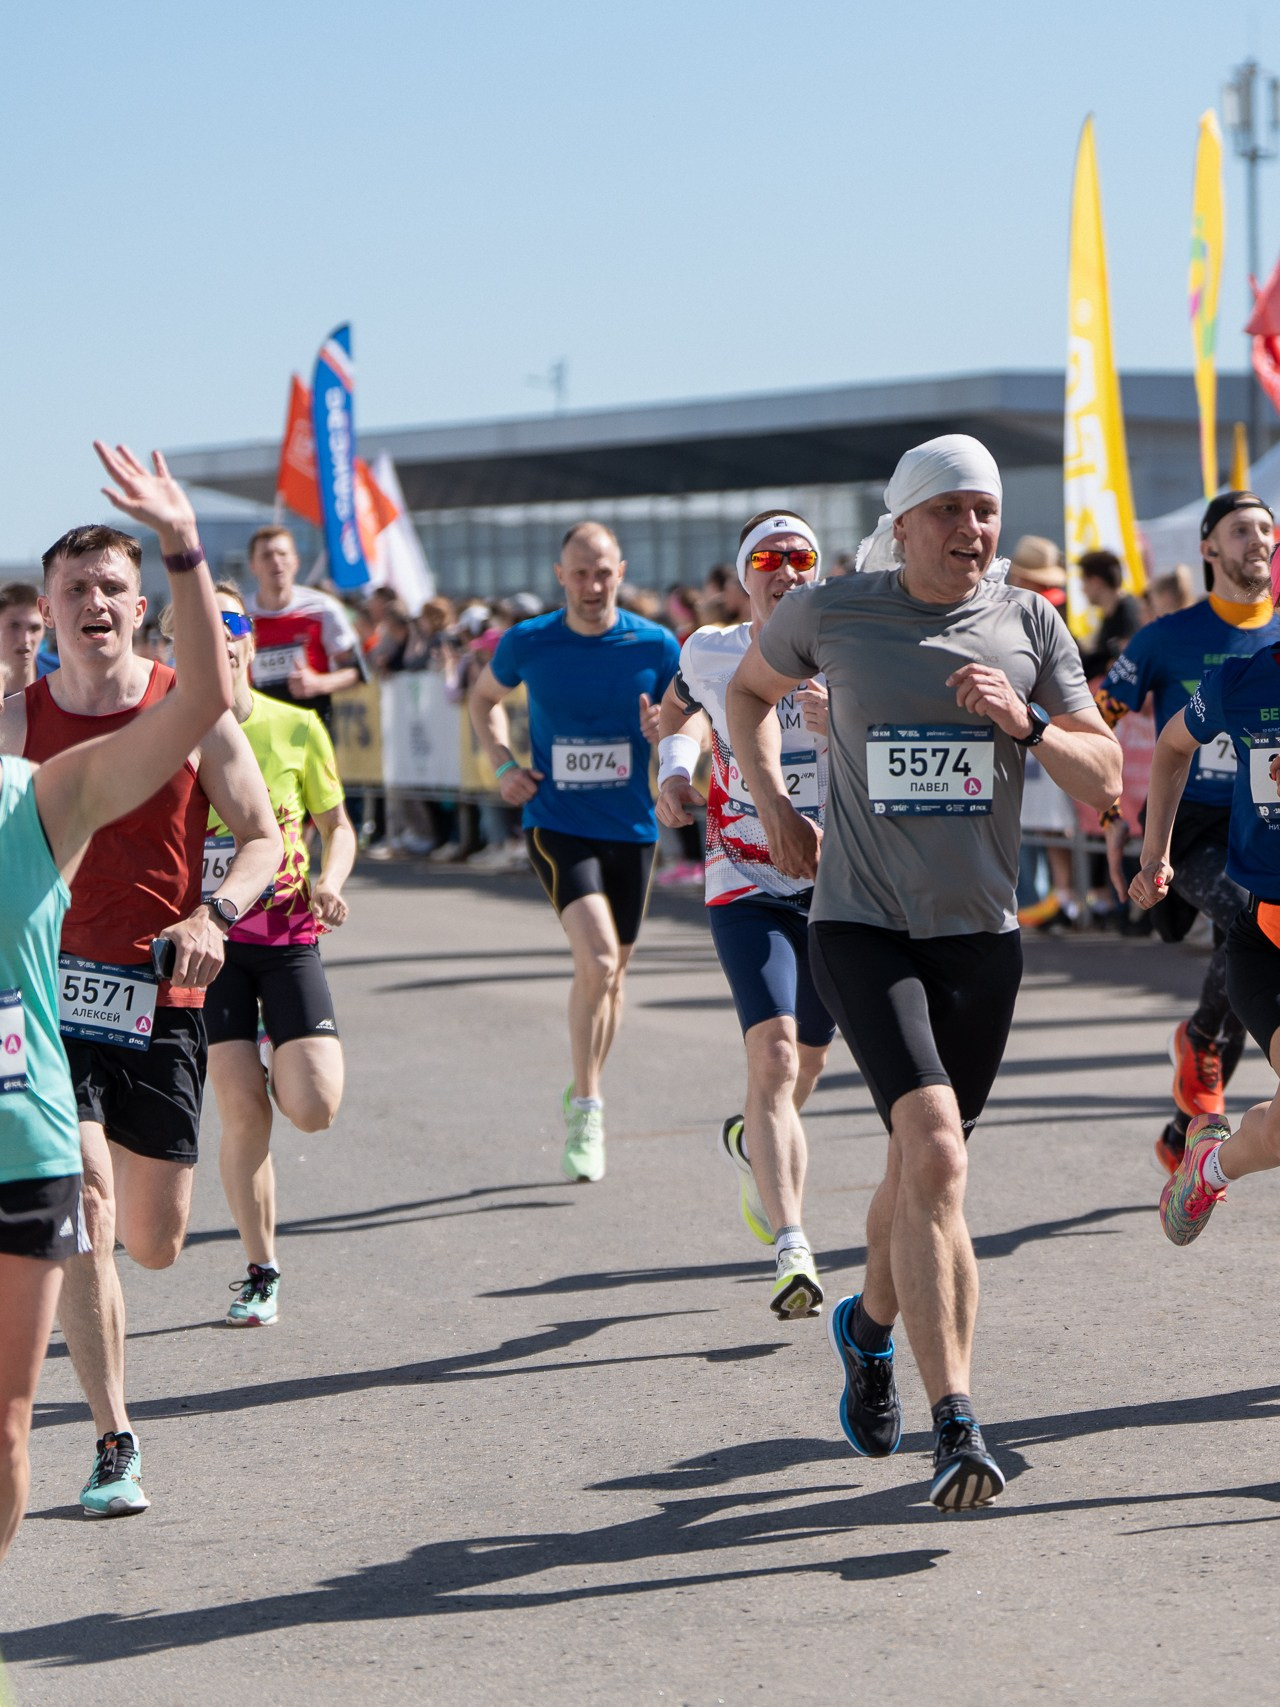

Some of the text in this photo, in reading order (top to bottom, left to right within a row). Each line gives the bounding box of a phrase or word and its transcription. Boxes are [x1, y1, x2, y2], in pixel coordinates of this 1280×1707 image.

[566, 752, 617, 771] 8074
[889, 748, 971, 777] 5574
[910, 782, 949, 792] ПАВЕЛ
[62, 975, 135, 1012] 5571
[72, 1007, 121, 1023] АЛЕКСЕЙ
